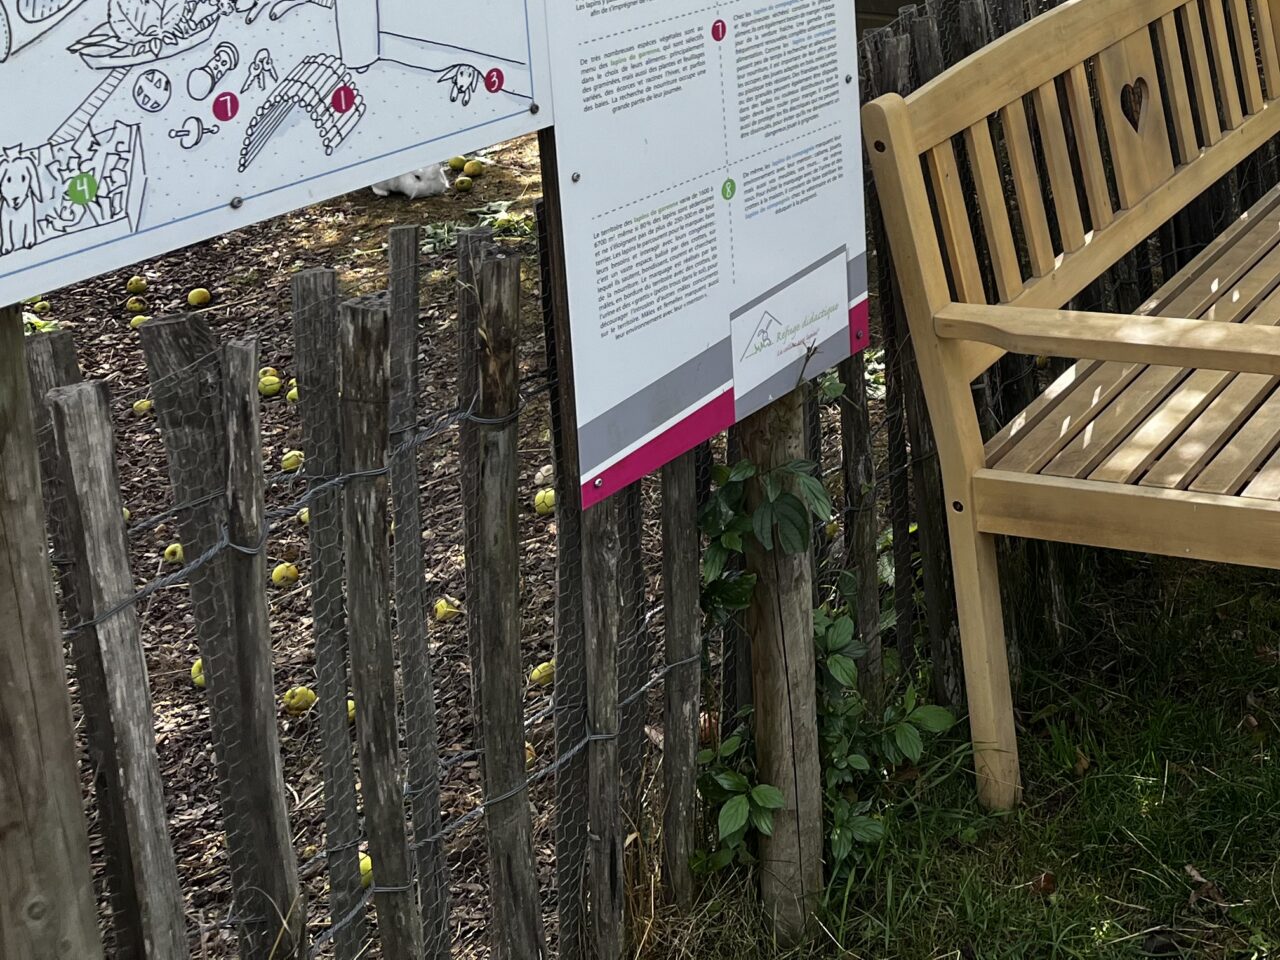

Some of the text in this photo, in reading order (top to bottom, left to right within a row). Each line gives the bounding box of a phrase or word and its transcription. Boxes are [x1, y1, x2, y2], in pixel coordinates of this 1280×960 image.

[714, 22, 722, 38] 7
[490, 71, 499, 90] 3
[219, 95, 232, 117] 7
[340, 90, 346, 110] 1
[76, 177, 89, 200] 4
[725, 181, 731, 198] 8
